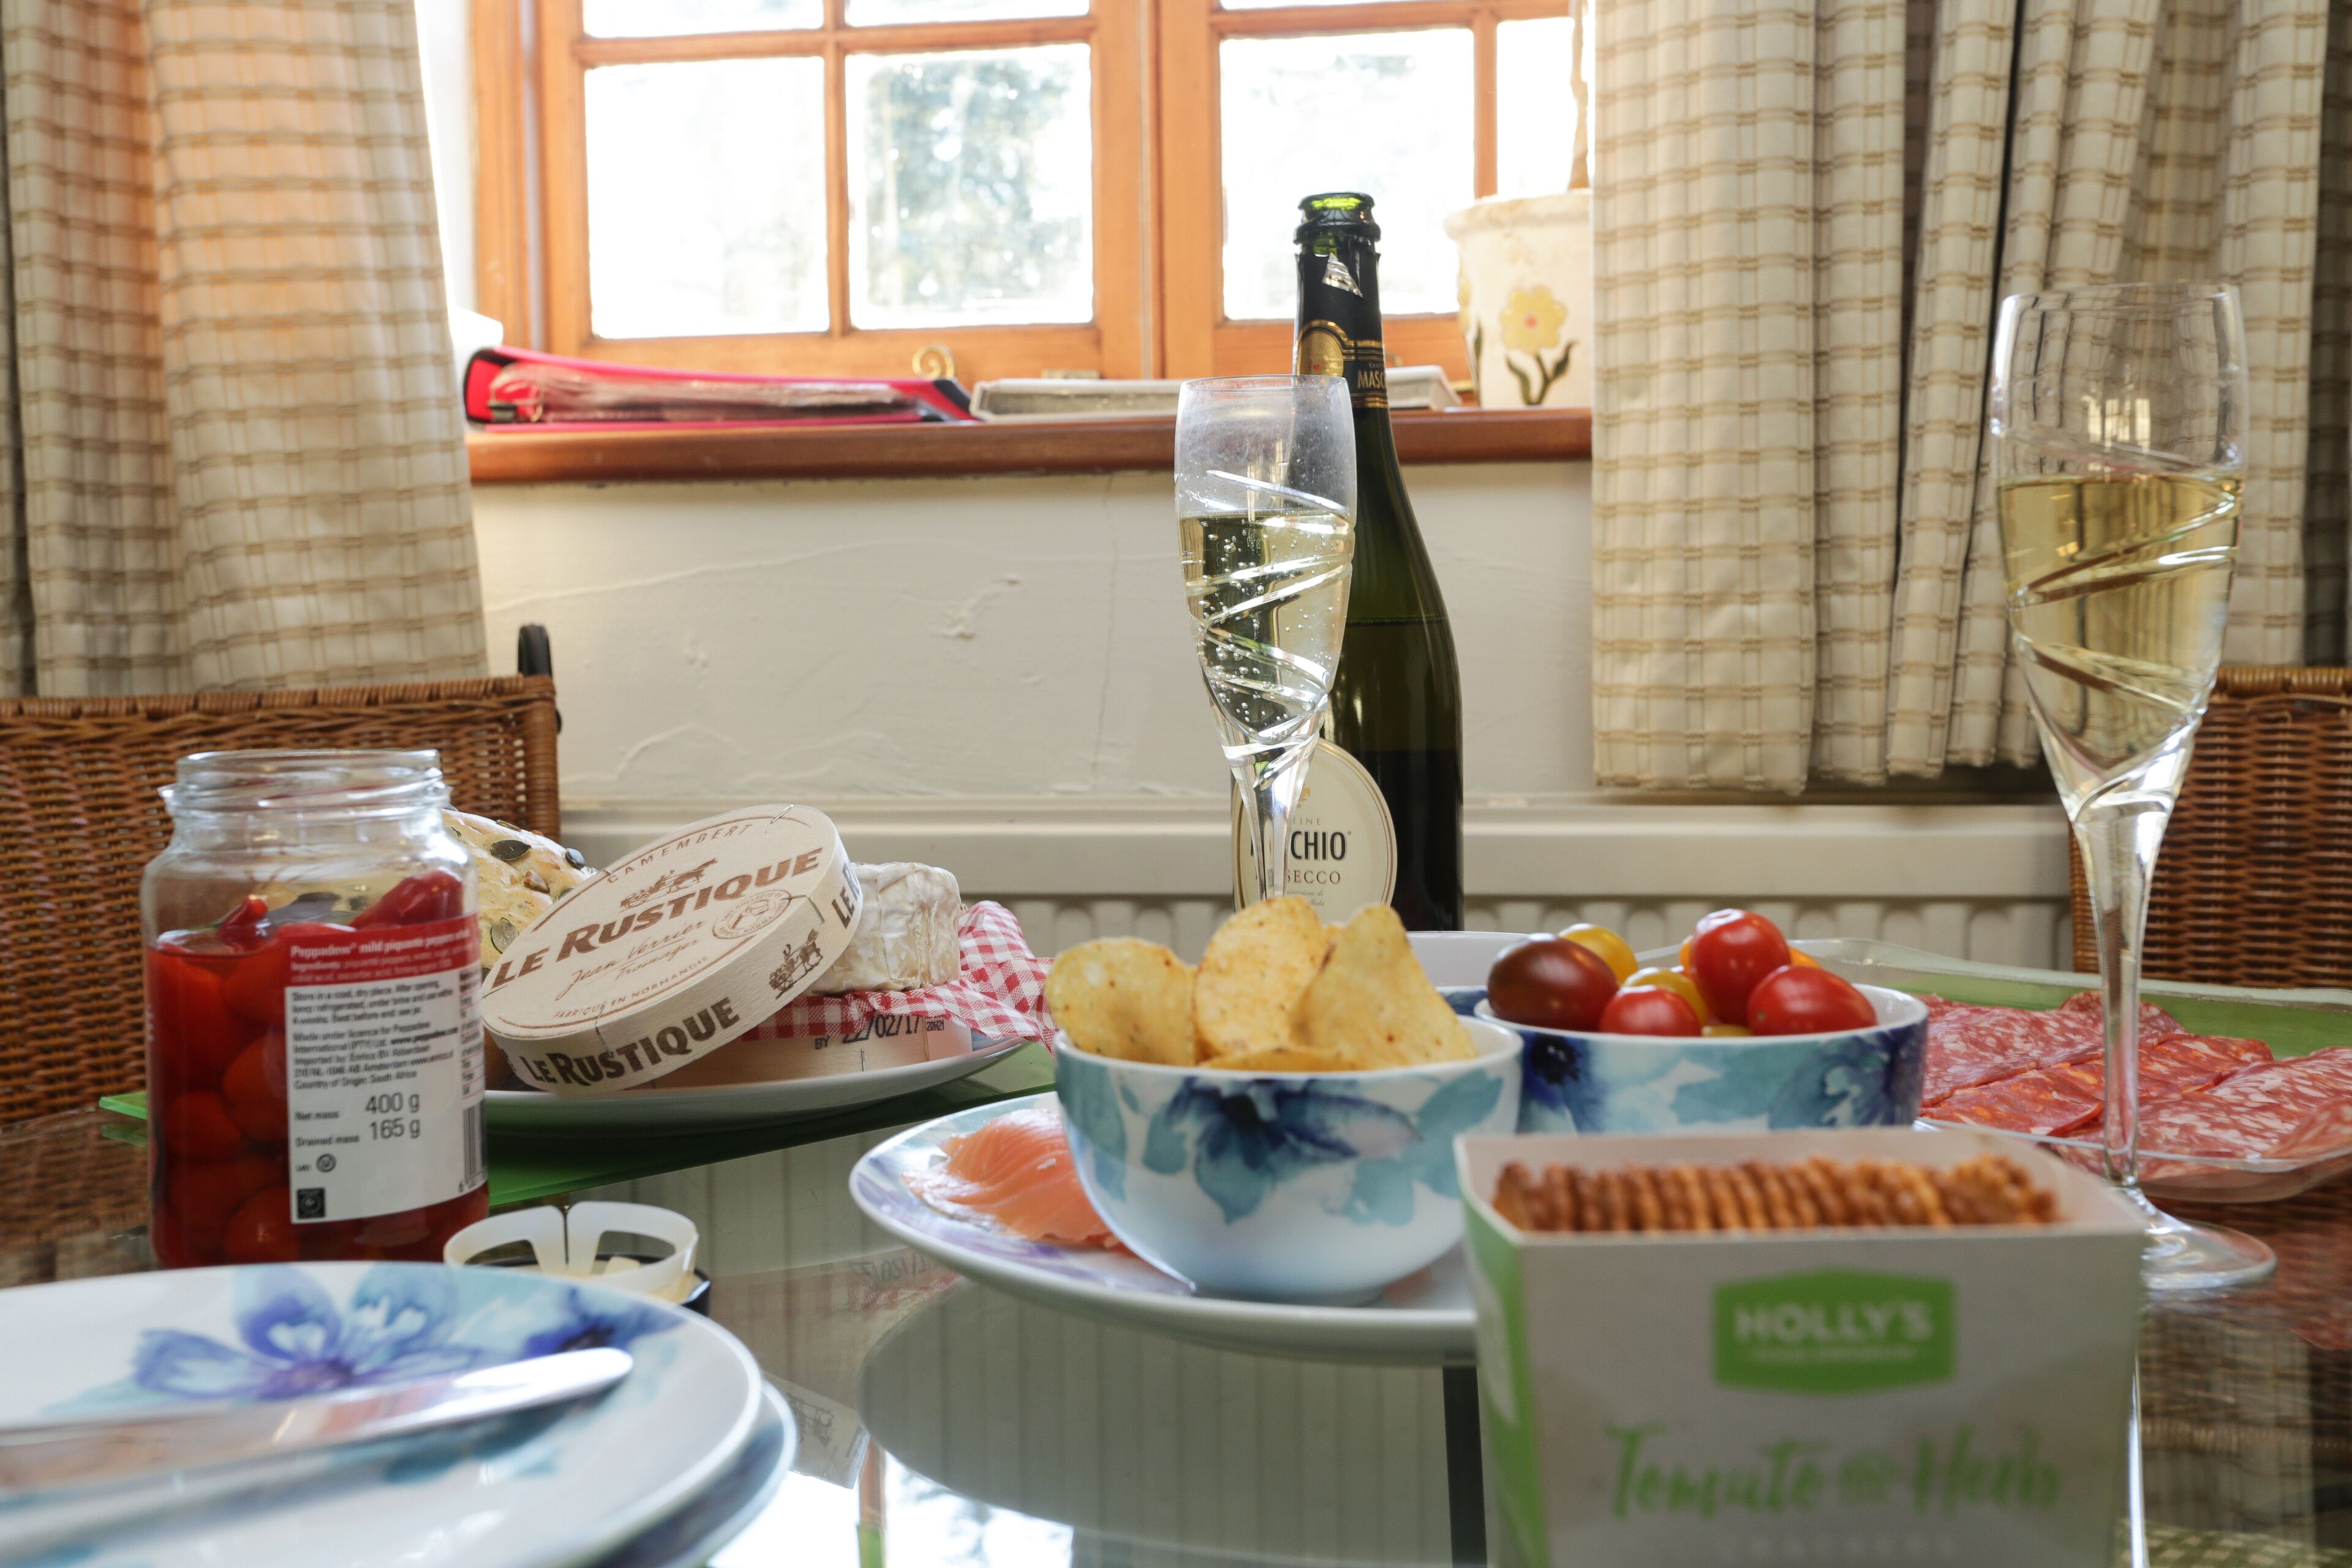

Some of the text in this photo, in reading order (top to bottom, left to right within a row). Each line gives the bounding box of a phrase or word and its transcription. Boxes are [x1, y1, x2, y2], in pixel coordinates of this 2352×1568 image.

[606, 823, 753, 884] CAMEMBERT
[1290, 831, 1348, 861] CHIO
[491, 947, 550, 989] LE
[556, 846, 824, 963] RUSTIQUE
[556, 921, 707, 1002] Jean Verrier
[611, 997, 626, 1007] EN
[631, 957, 708, 999] NORMANDIE
[519, 1056, 557, 1084] LE
[547, 1002, 740, 1087] RUSTIQUE
[843, 1013, 920, 1044] /02/17
[366, 1091, 404, 1115] 400
[409, 1093, 420, 1114] g
[369, 1117, 421, 1140] 165 g
